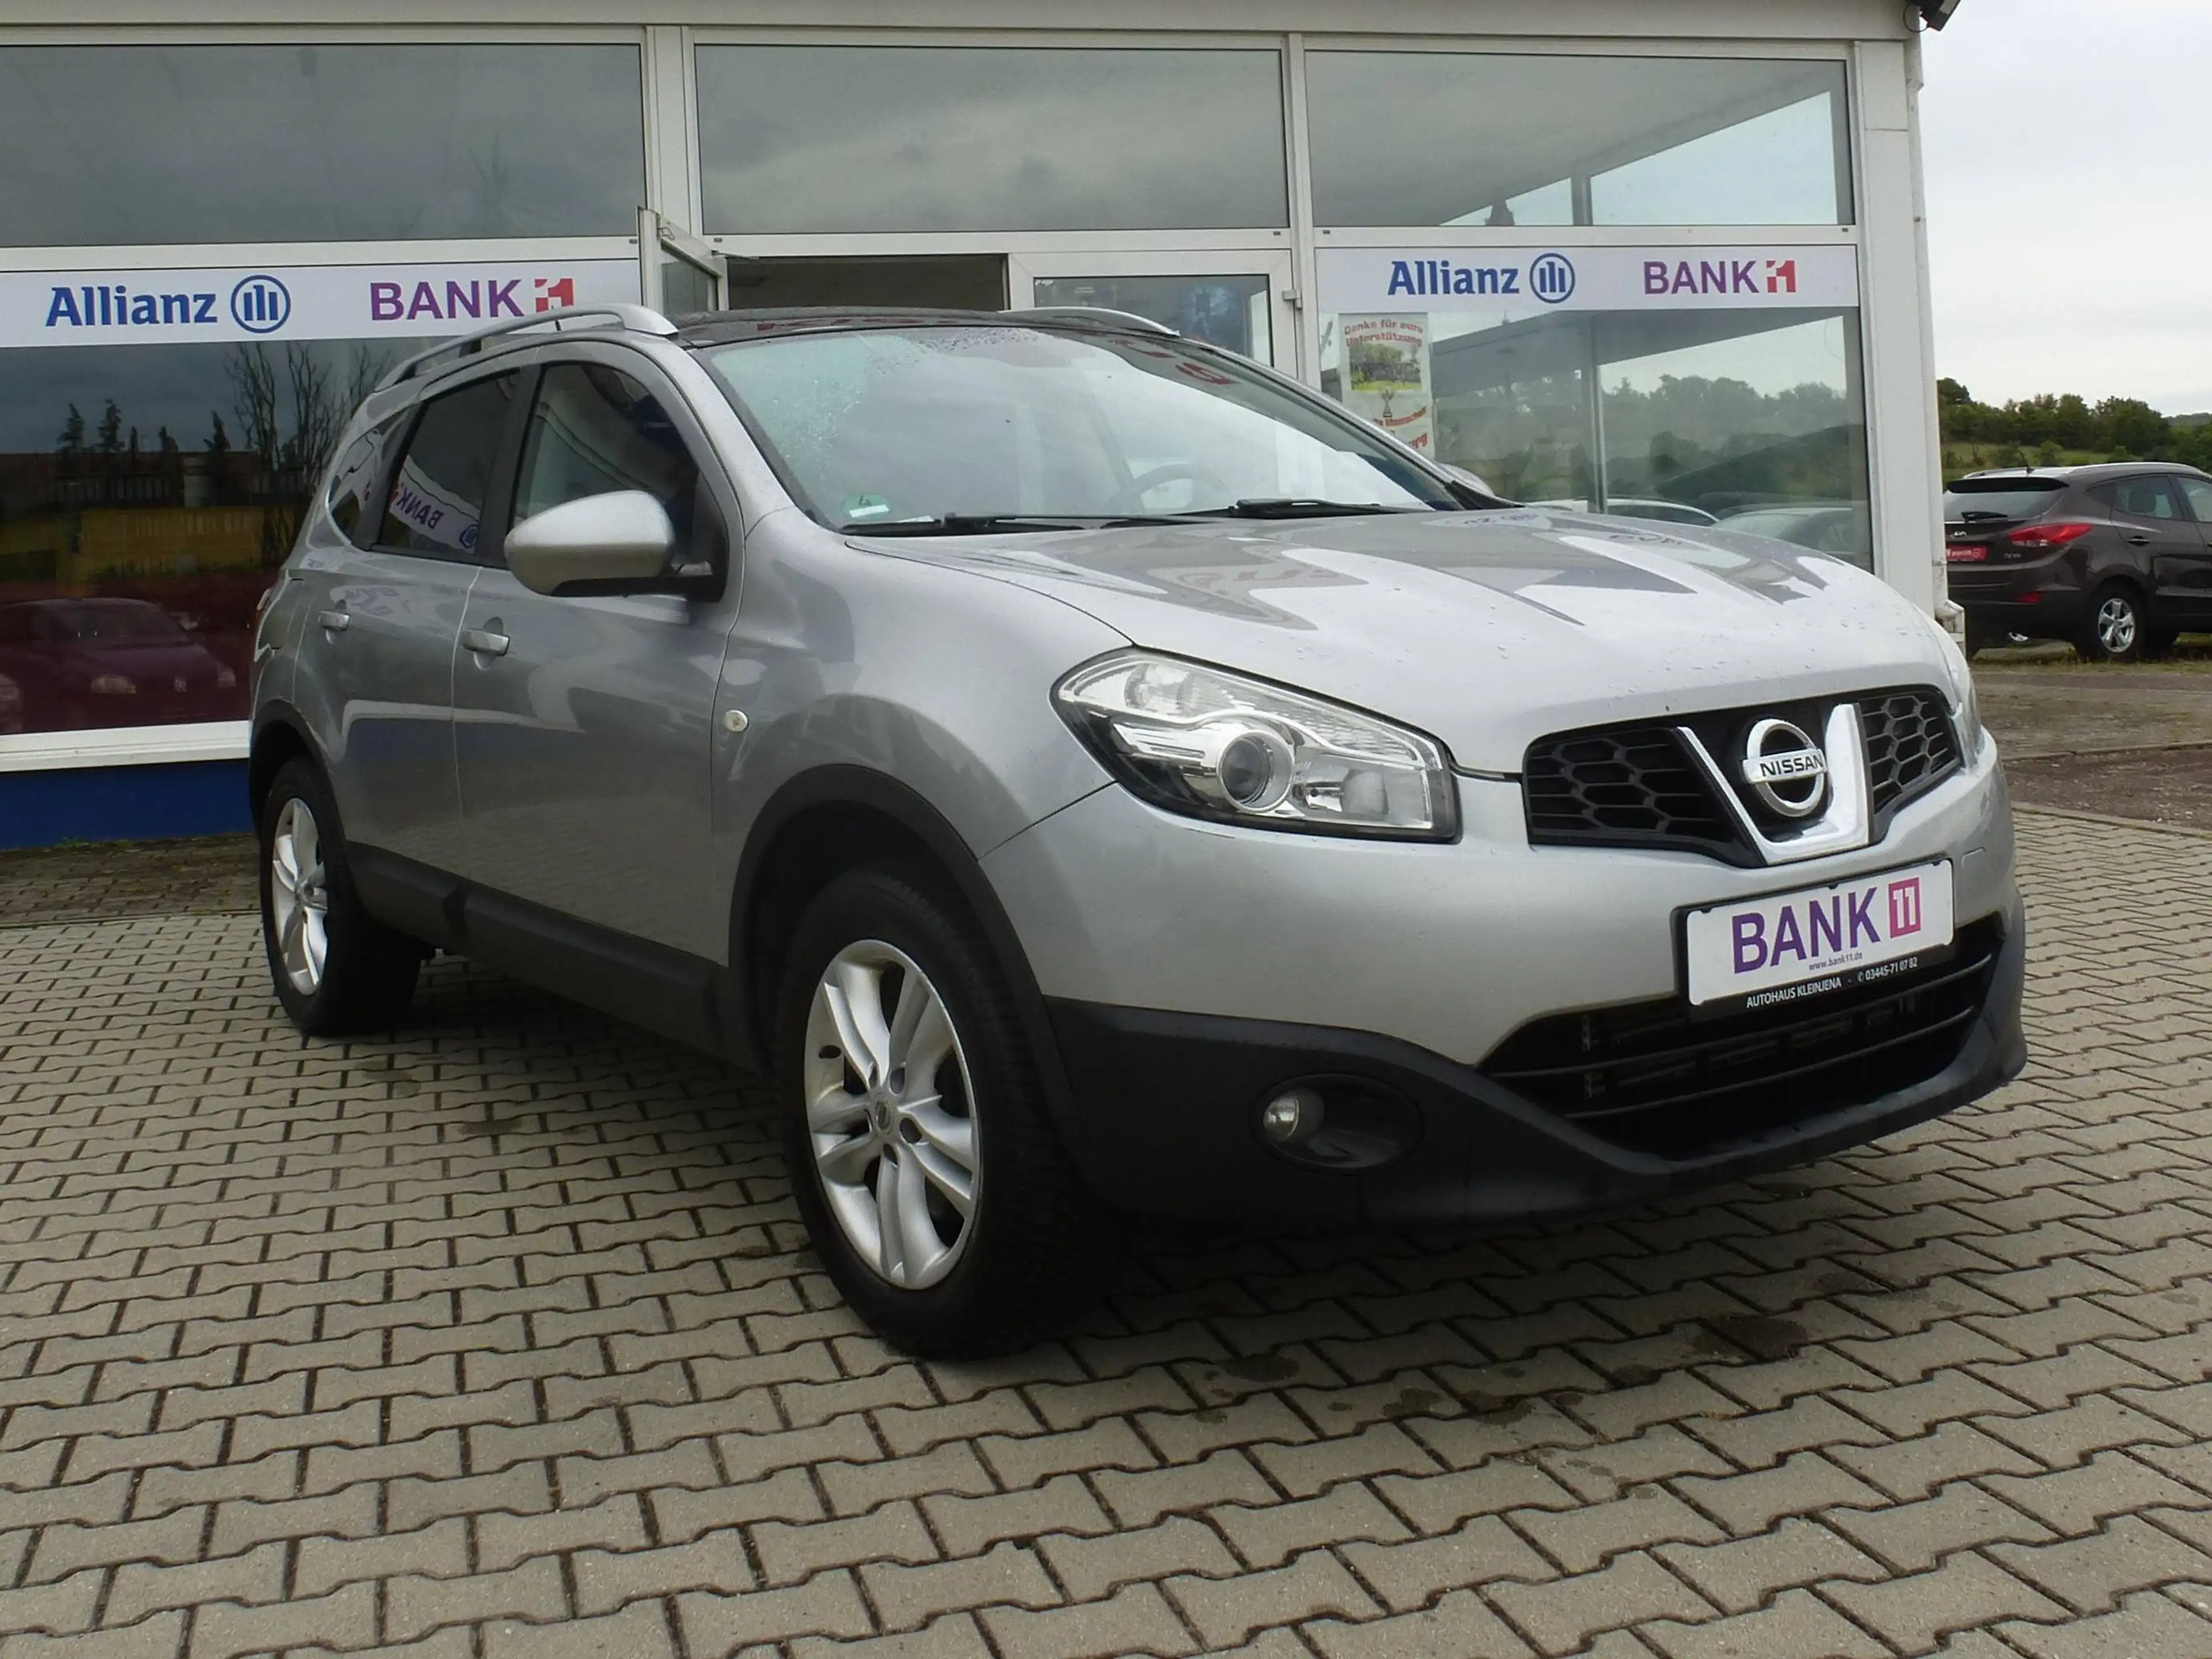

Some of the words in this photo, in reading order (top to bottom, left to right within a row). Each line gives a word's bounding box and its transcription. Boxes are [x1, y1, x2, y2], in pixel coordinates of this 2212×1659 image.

[1387, 260, 1519, 296] Allianz
[1644, 260, 1759, 294] BANK
[46, 286, 218, 327] Allianz
[370, 279, 524, 320] BANK
[1346, 332, 1422, 347] Unterstützung
[1381, 319, 1397, 328] für
[1760, 754, 1824, 777] NISSAN
[1732, 887, 1881, 974] BANK
[1892, 885, 1918, 930] 11
[1809, 951, 1862, 971] www.bank11.de
[1746, 987, 1796, 1008] AUTOHAUS
[1797, 977, 1842, 997] KLEINJENA
[1865, 962, 1898, 980] 03445-71
